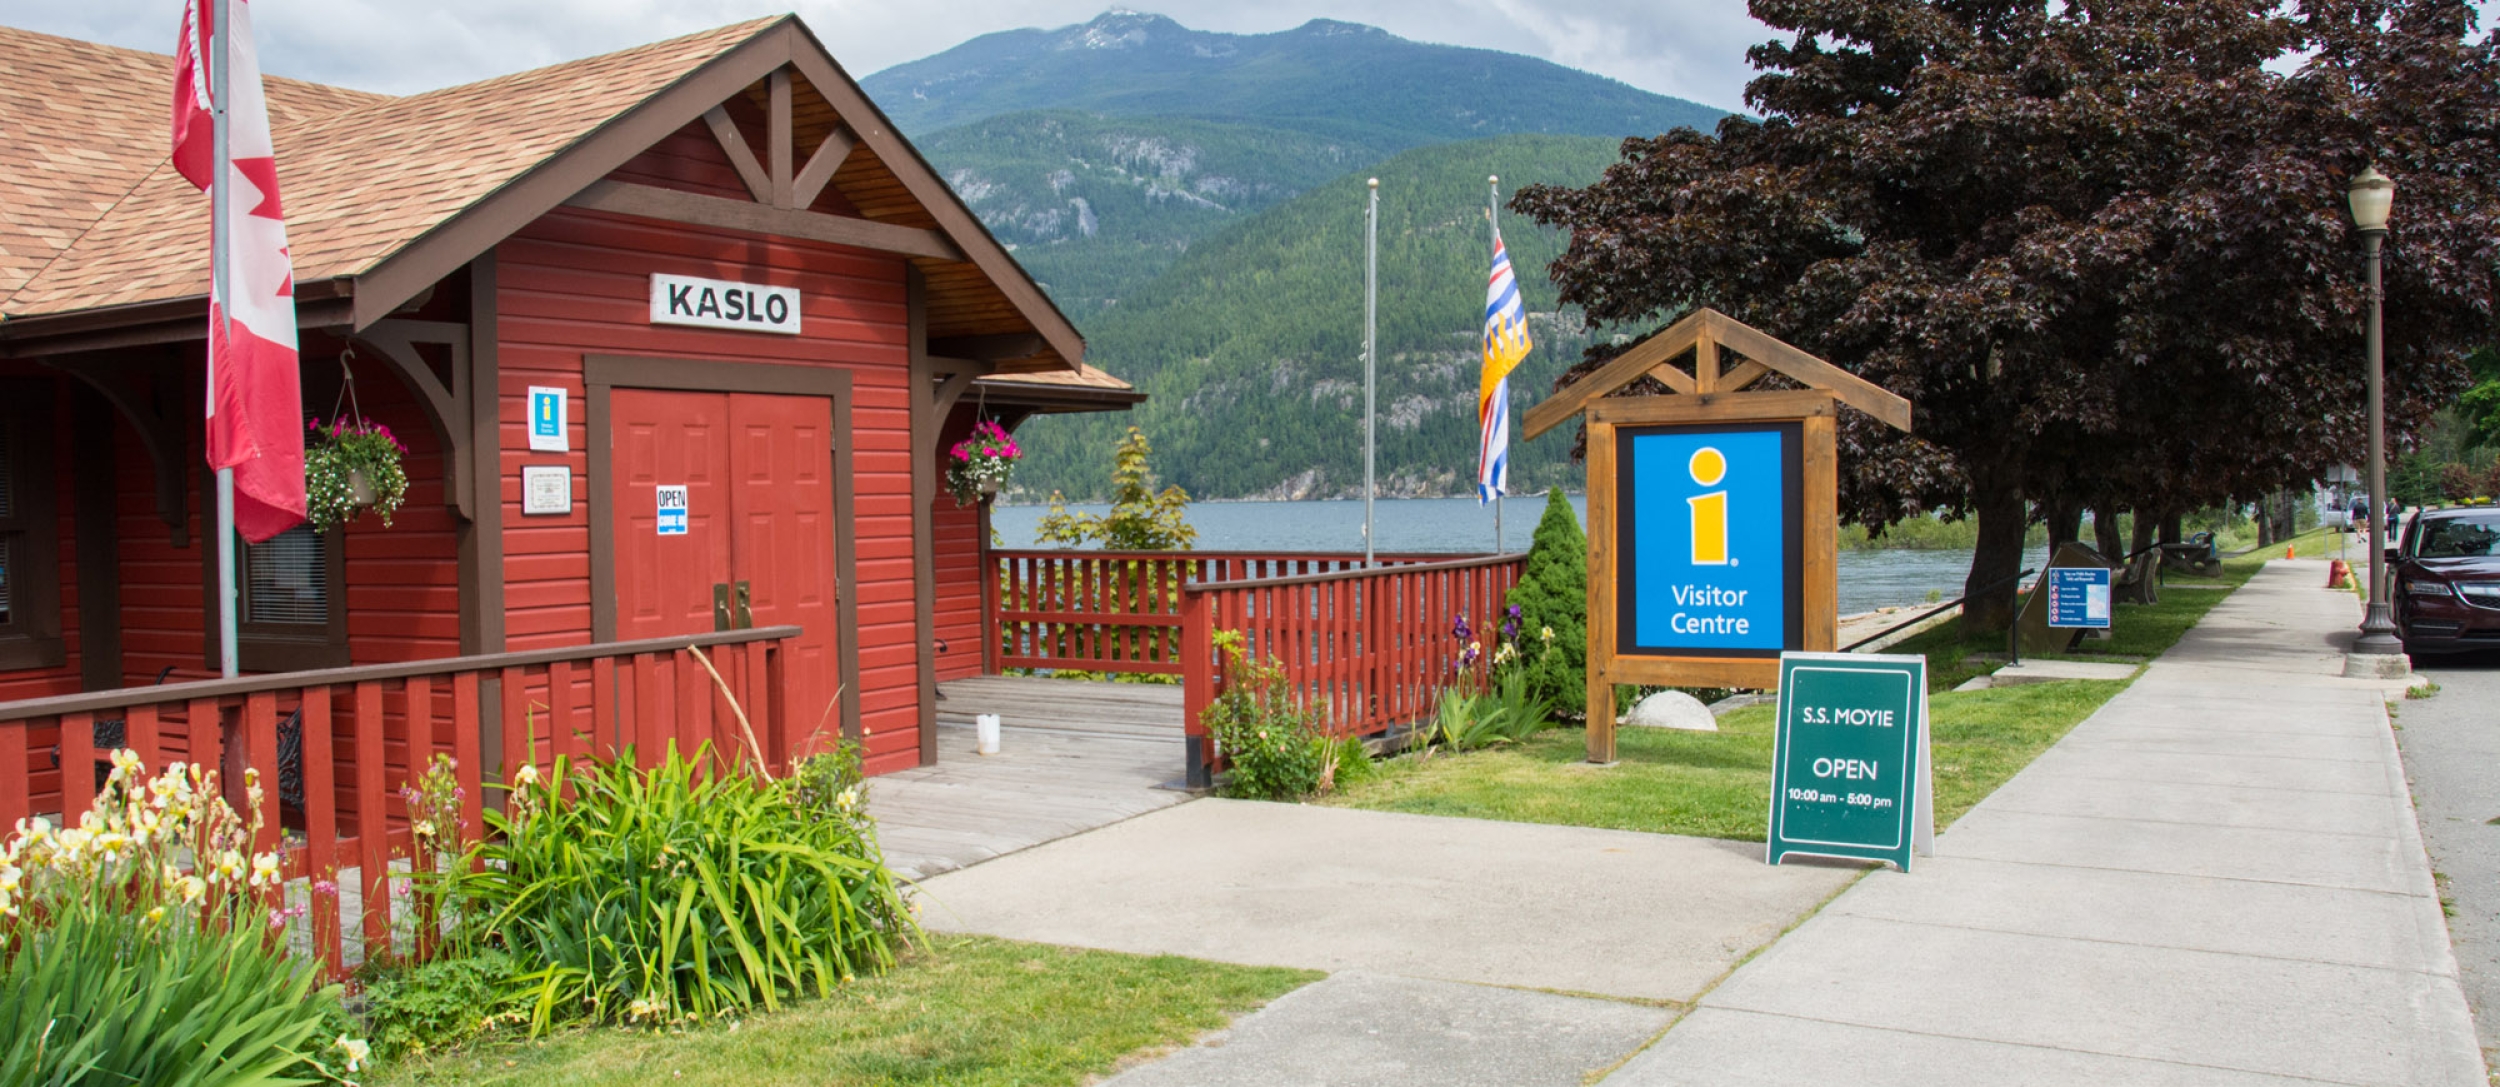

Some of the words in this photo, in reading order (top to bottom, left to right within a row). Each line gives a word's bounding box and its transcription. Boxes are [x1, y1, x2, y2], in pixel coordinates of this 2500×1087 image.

[669, 283, 788, 324] KASLO
[658, 490, 686, 507] OPEN
[1671, 584, 1748, 606] Visitor
[1670, 612, 1749, 635] Centre
[1803, 707, 1830, 724] S.S.
[1834, 708, 1894, 727] MOYIE
[1812, 757, 1877, 780] OPEN
[1788, 787, 1818, 802] 10:00
[1819, 793, 1836, 803] am
[1847, 793, 1871, 805] 5:00
[1873, 796, 1892, 808] pm
